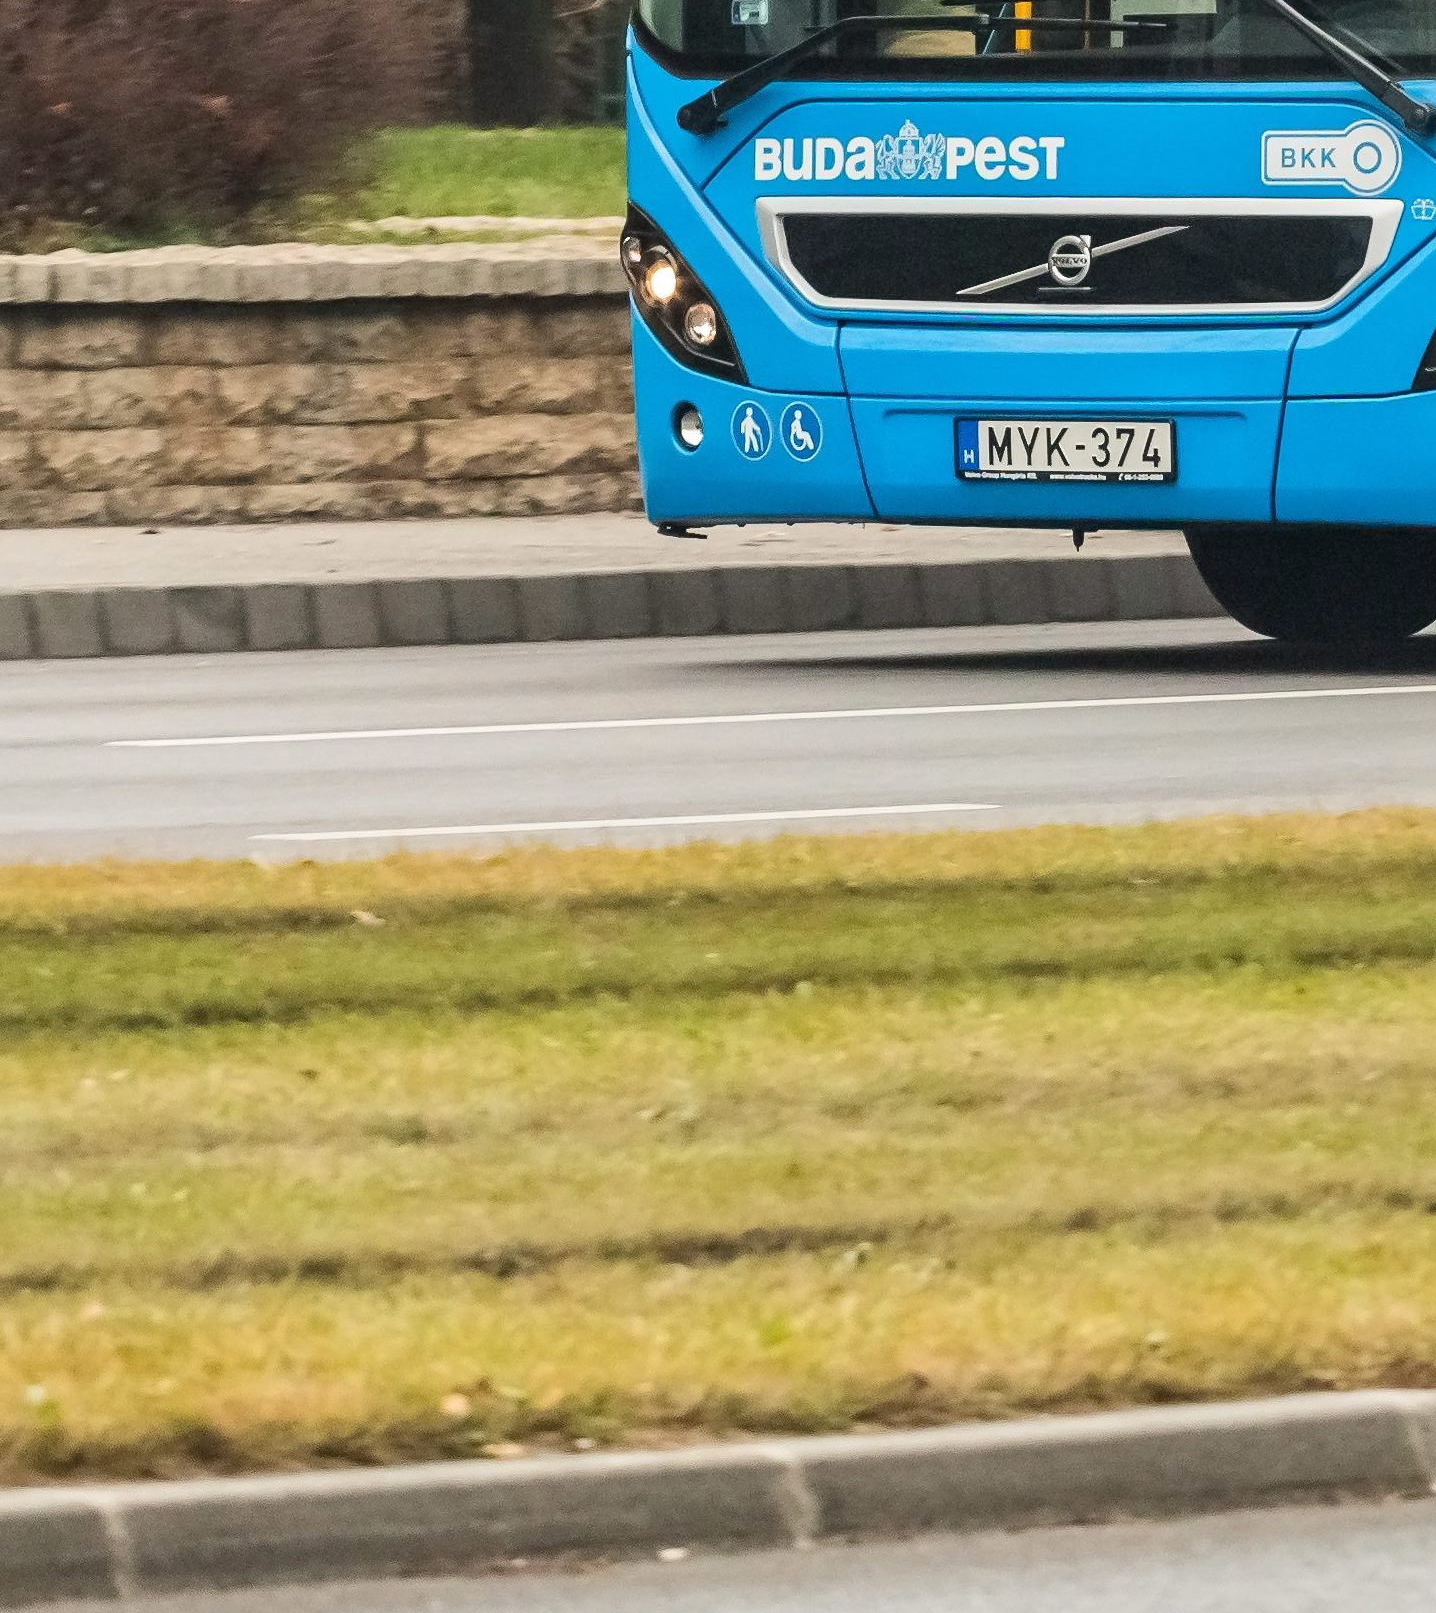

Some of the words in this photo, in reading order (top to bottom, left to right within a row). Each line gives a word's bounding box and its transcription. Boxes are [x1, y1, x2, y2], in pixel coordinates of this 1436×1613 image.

[1281, 148, 1336, 168] BKK
[964, 449, 974, 464] H
[988, 426, 1161, 468] MYK-374
